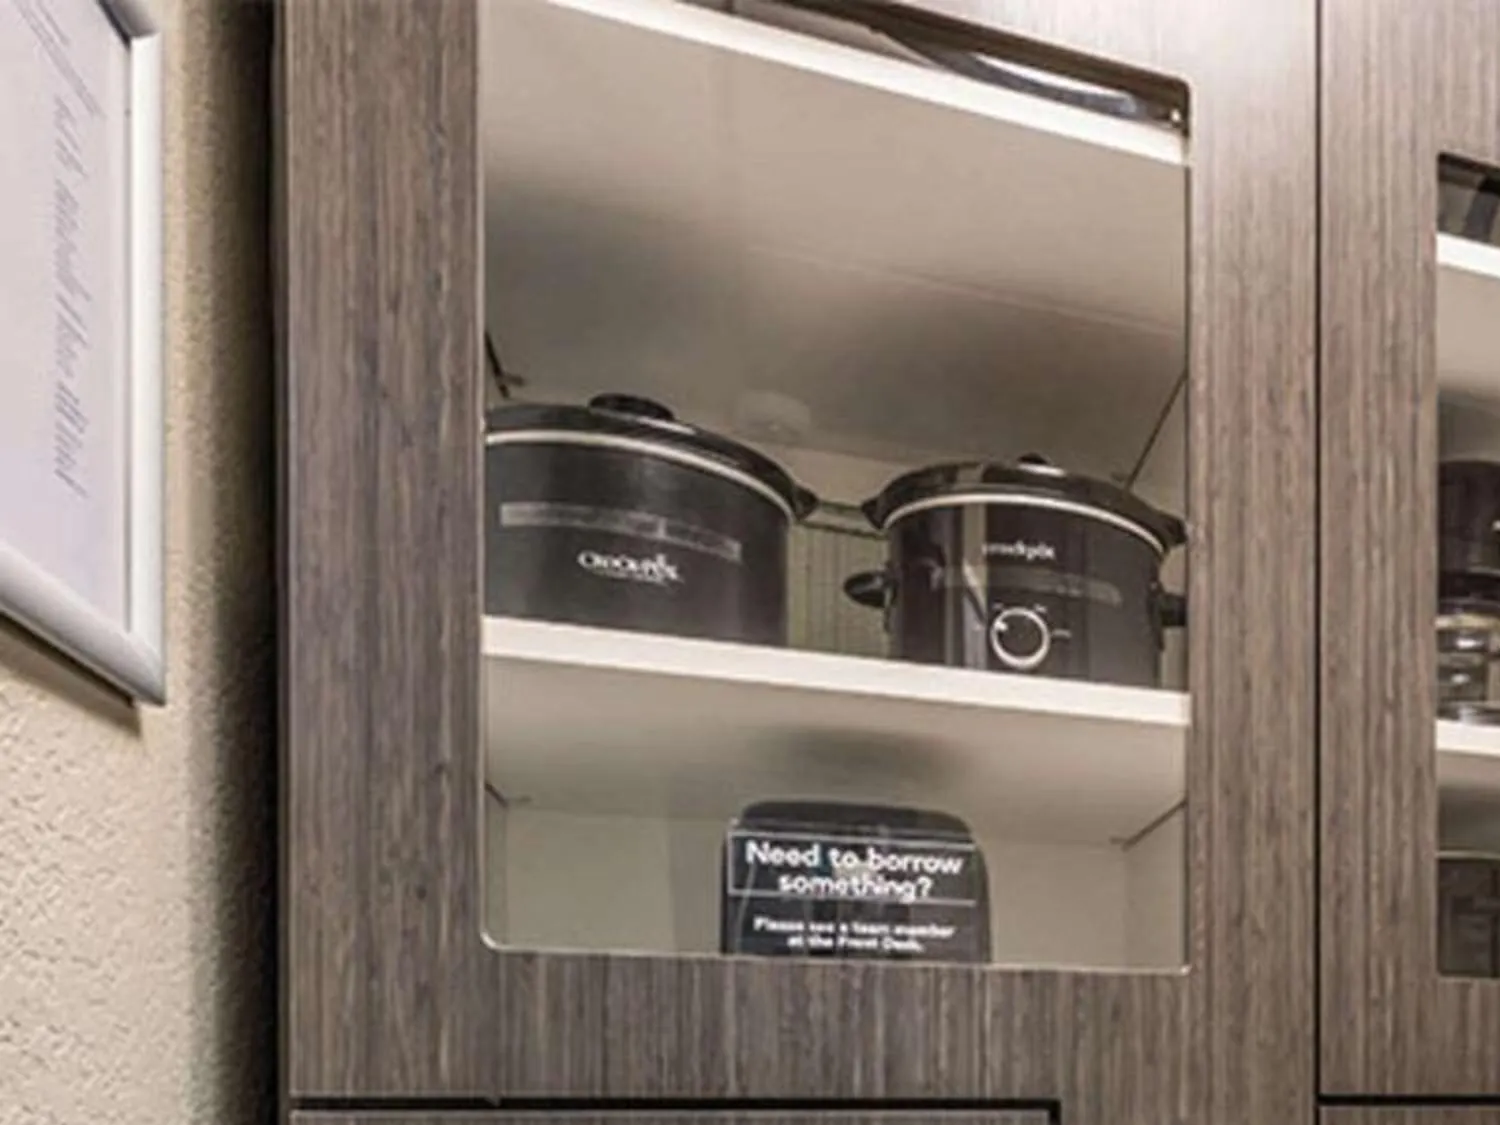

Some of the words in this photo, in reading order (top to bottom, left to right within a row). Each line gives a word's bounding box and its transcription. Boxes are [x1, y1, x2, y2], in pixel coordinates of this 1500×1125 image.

[745, 840, 820, 867] Need
[829, 848, 858, 869] to
[868, 846, 964, 875] borrow
[778, 871, 933, 904] something?
